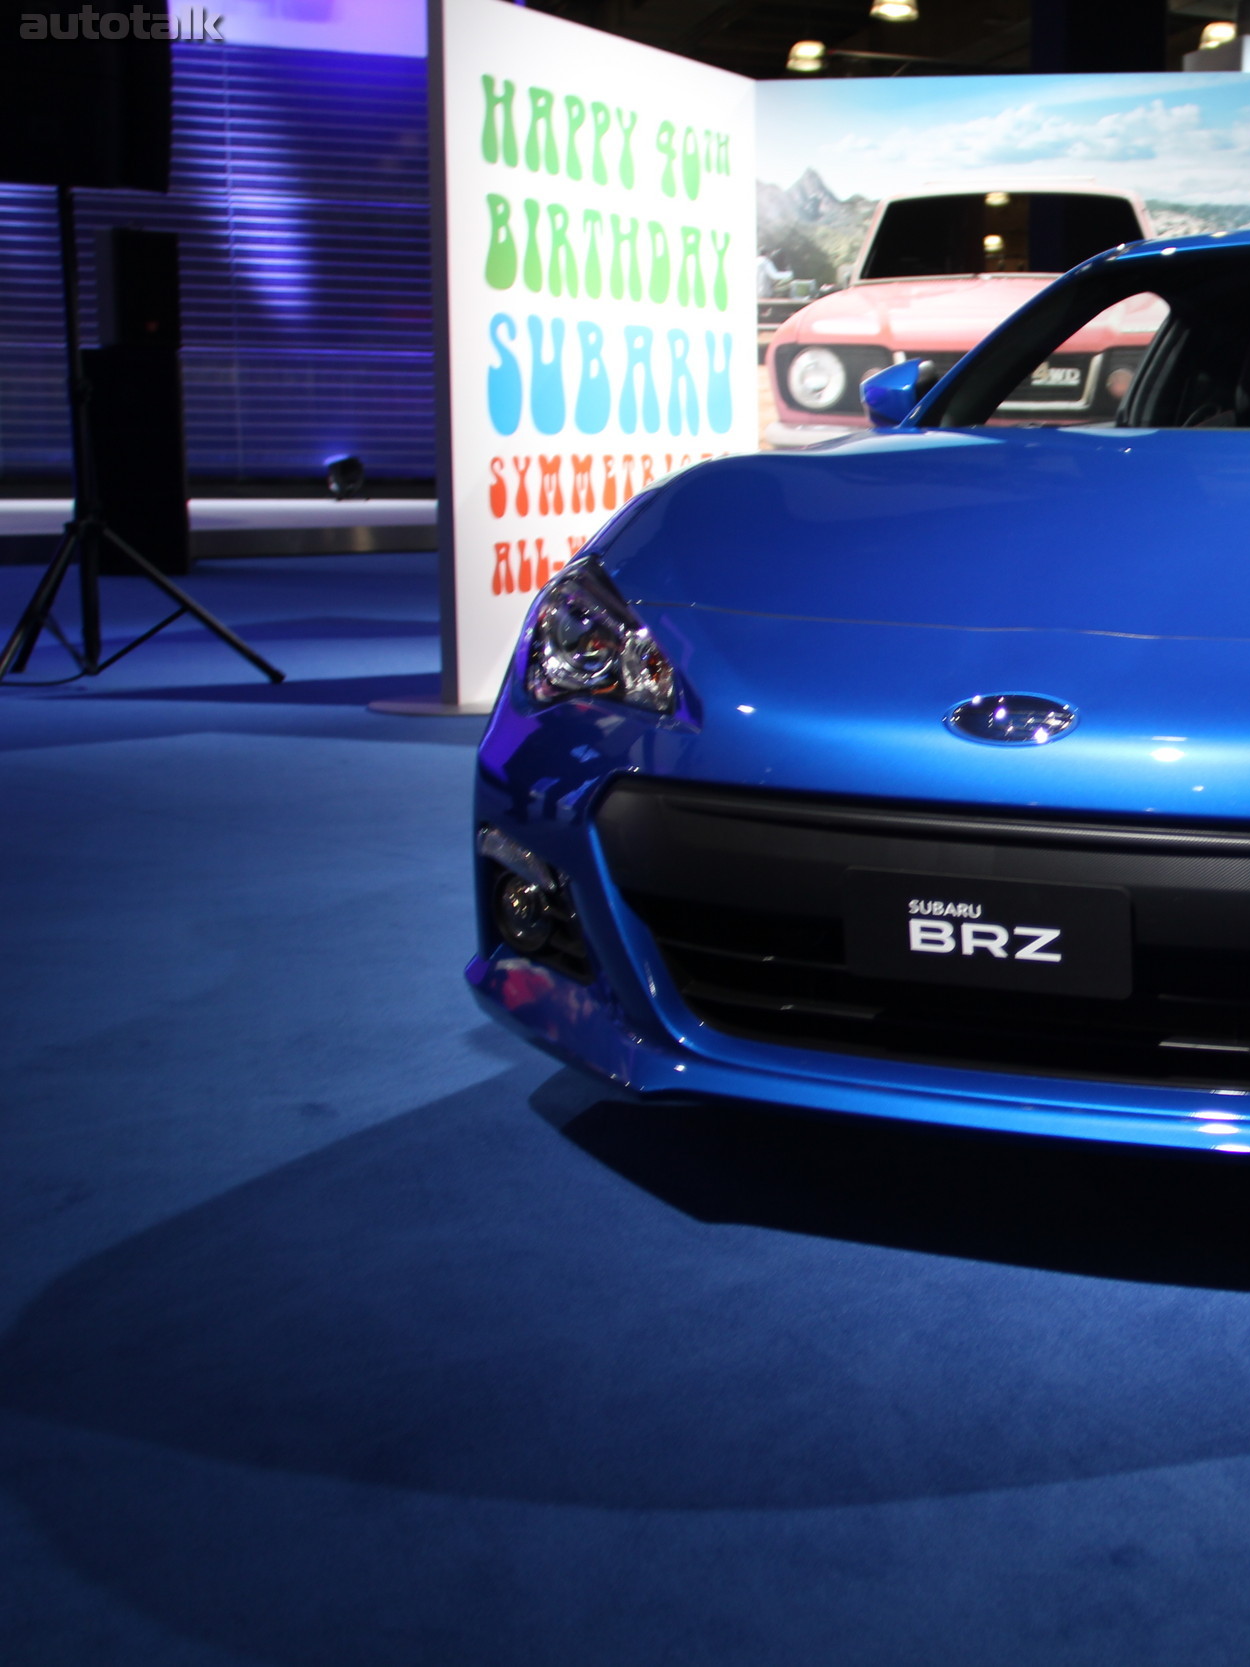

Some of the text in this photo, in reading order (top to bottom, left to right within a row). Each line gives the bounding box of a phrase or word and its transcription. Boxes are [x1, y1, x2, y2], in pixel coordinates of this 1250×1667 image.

[481, 74, 638, 190] HAPPY
[485, 193, 731, 312] BIRTHDAY
[488, 312, 733, 437] SUBARU
[908, 899, 981, 919] SUBARU
[909, 918, 1062, 963] BRZ
